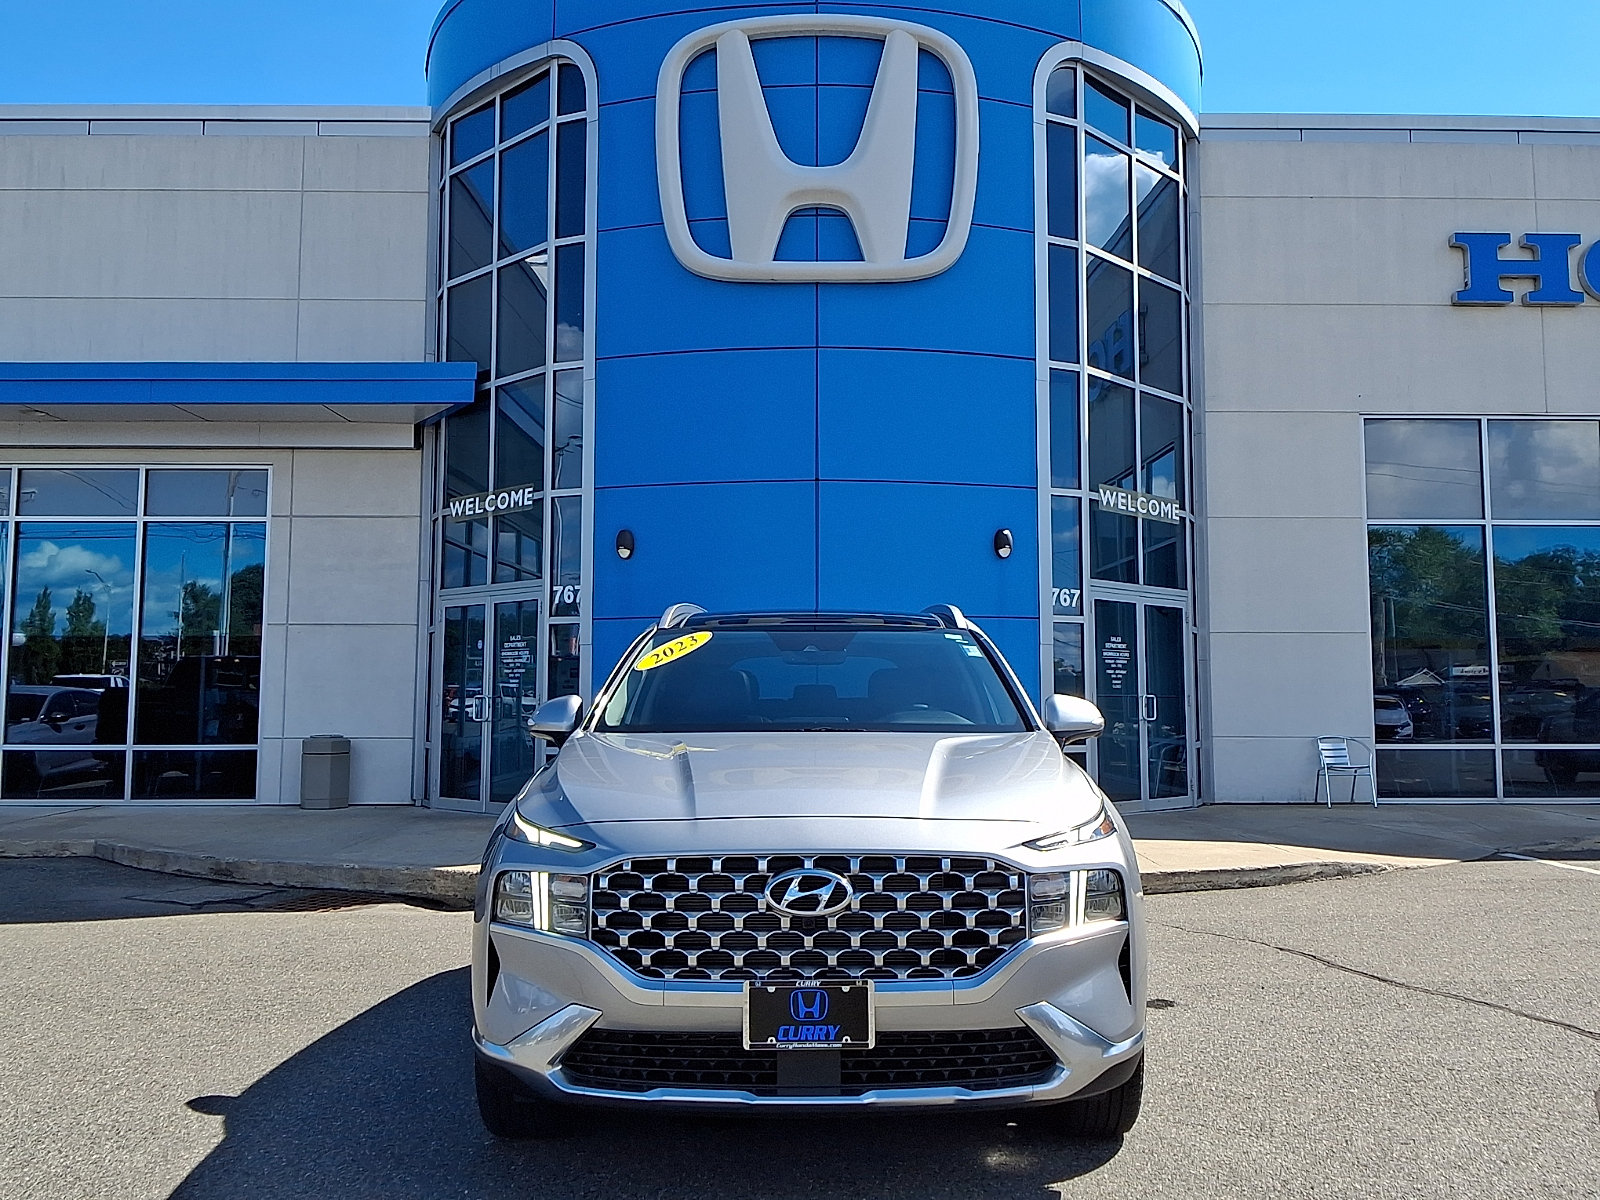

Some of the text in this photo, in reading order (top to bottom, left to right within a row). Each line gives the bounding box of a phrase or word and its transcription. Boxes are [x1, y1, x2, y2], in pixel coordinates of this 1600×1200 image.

[1449, 231, 1600, 306] H
[450, 487, 533, 518] WELCOME
[1099, 488, 1180, 521] WELCOME
[553, 585, 581, 604] 767
[1052, 588, 1080, 608] 767
[650, 635, 698, 664] 2023
[777, 1025, 841, 1041] CURRY
